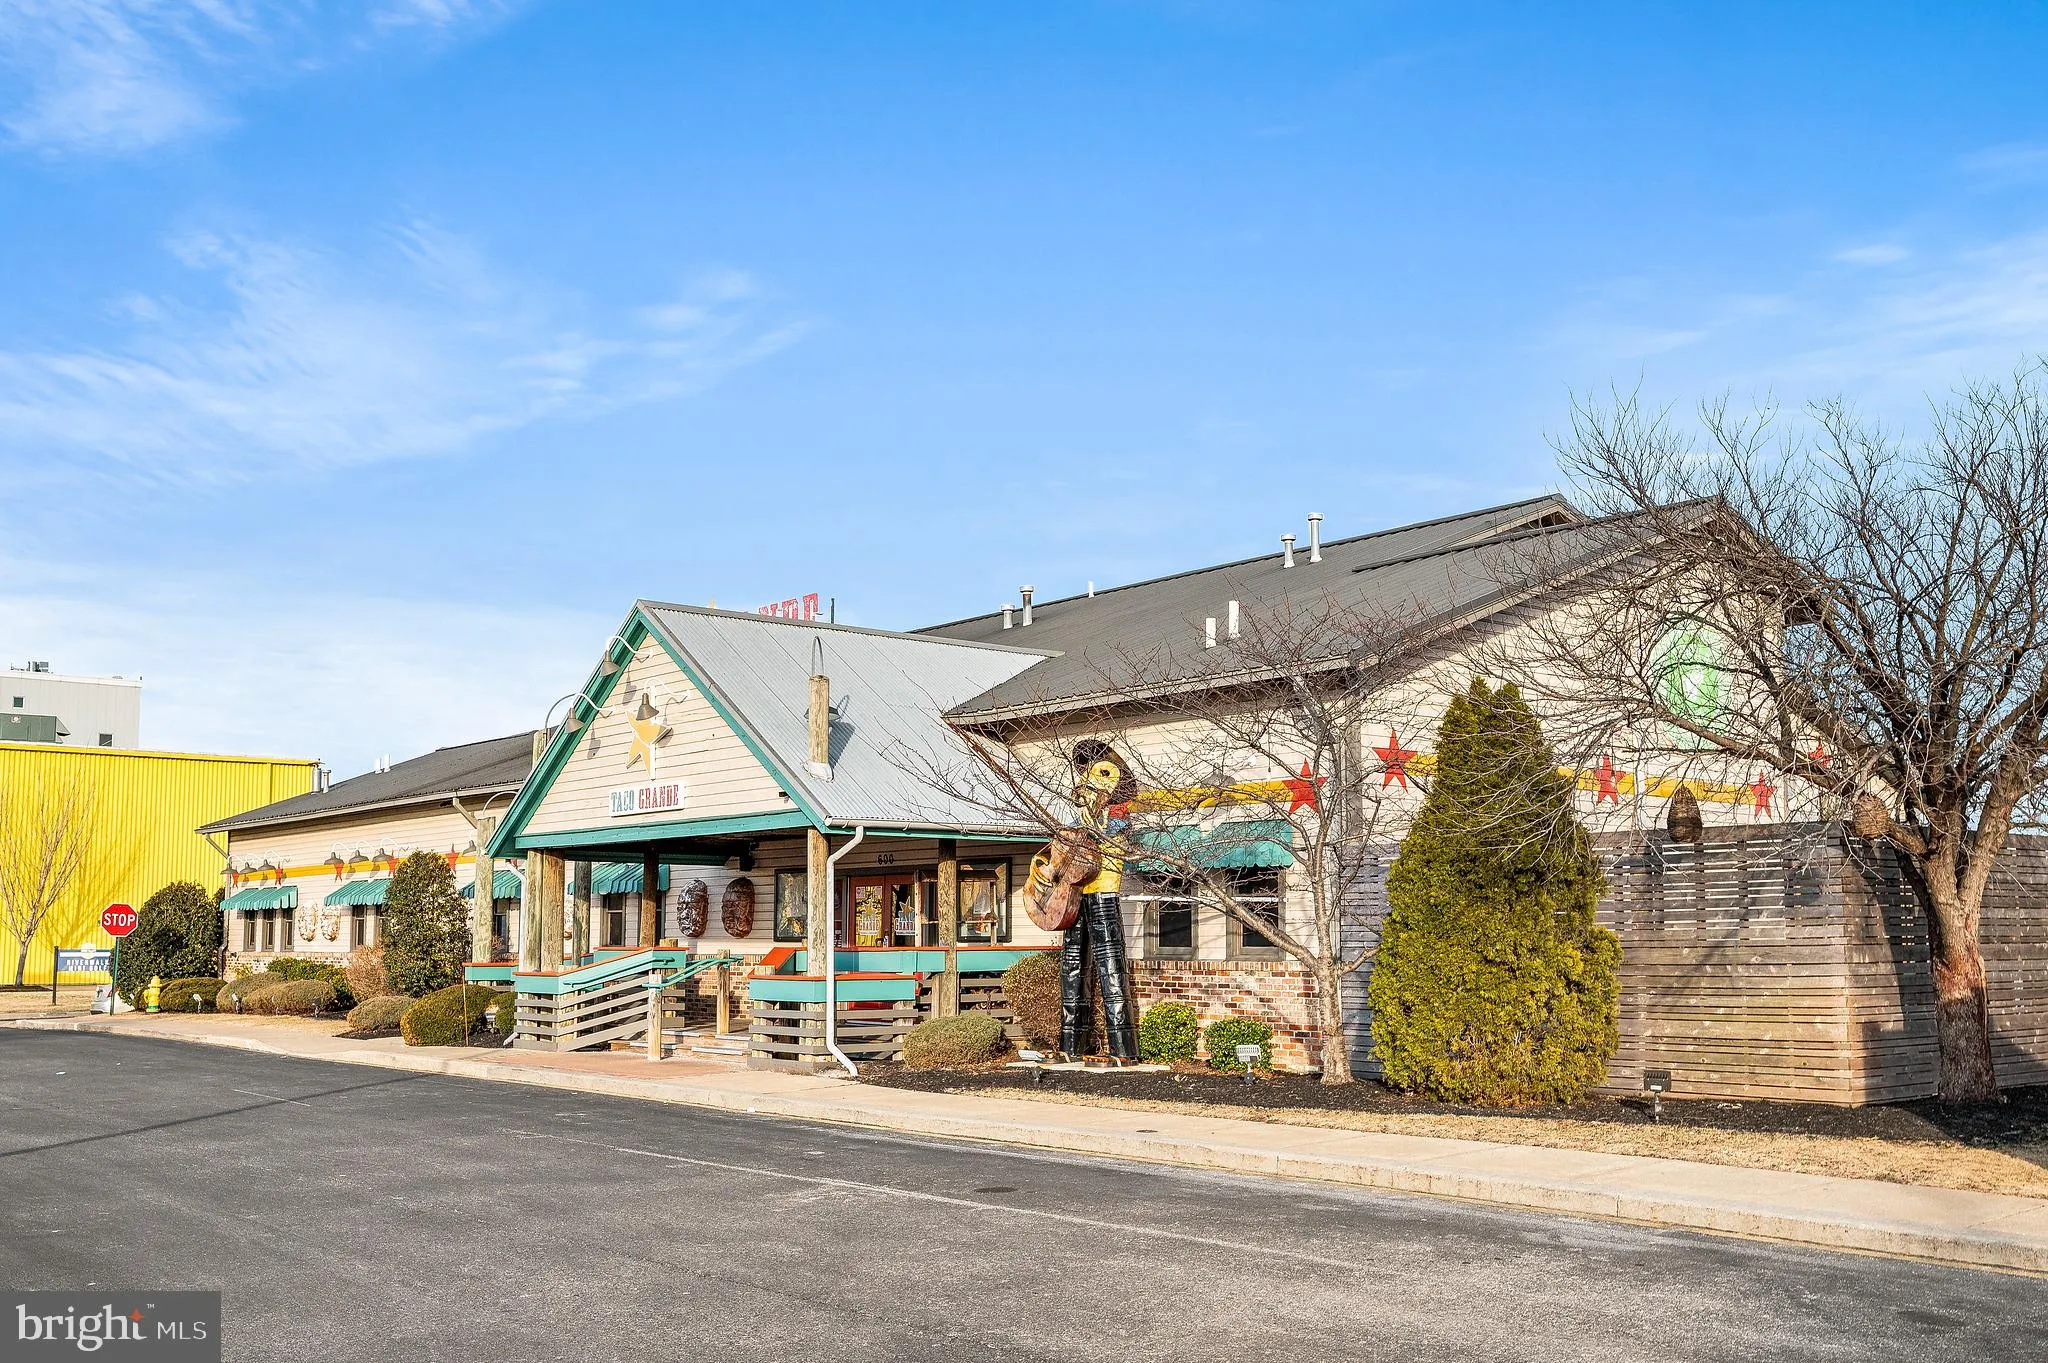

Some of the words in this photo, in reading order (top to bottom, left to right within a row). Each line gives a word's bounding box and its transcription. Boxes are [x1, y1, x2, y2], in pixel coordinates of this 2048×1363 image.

[611, 790, 635, 812] TACO
[638, 784, 679, 809] GRANDE
[877, 854, 894, 865] 600
[103, 913, 136, 927] STOP
[895, 918, 915, 931] GRAND
